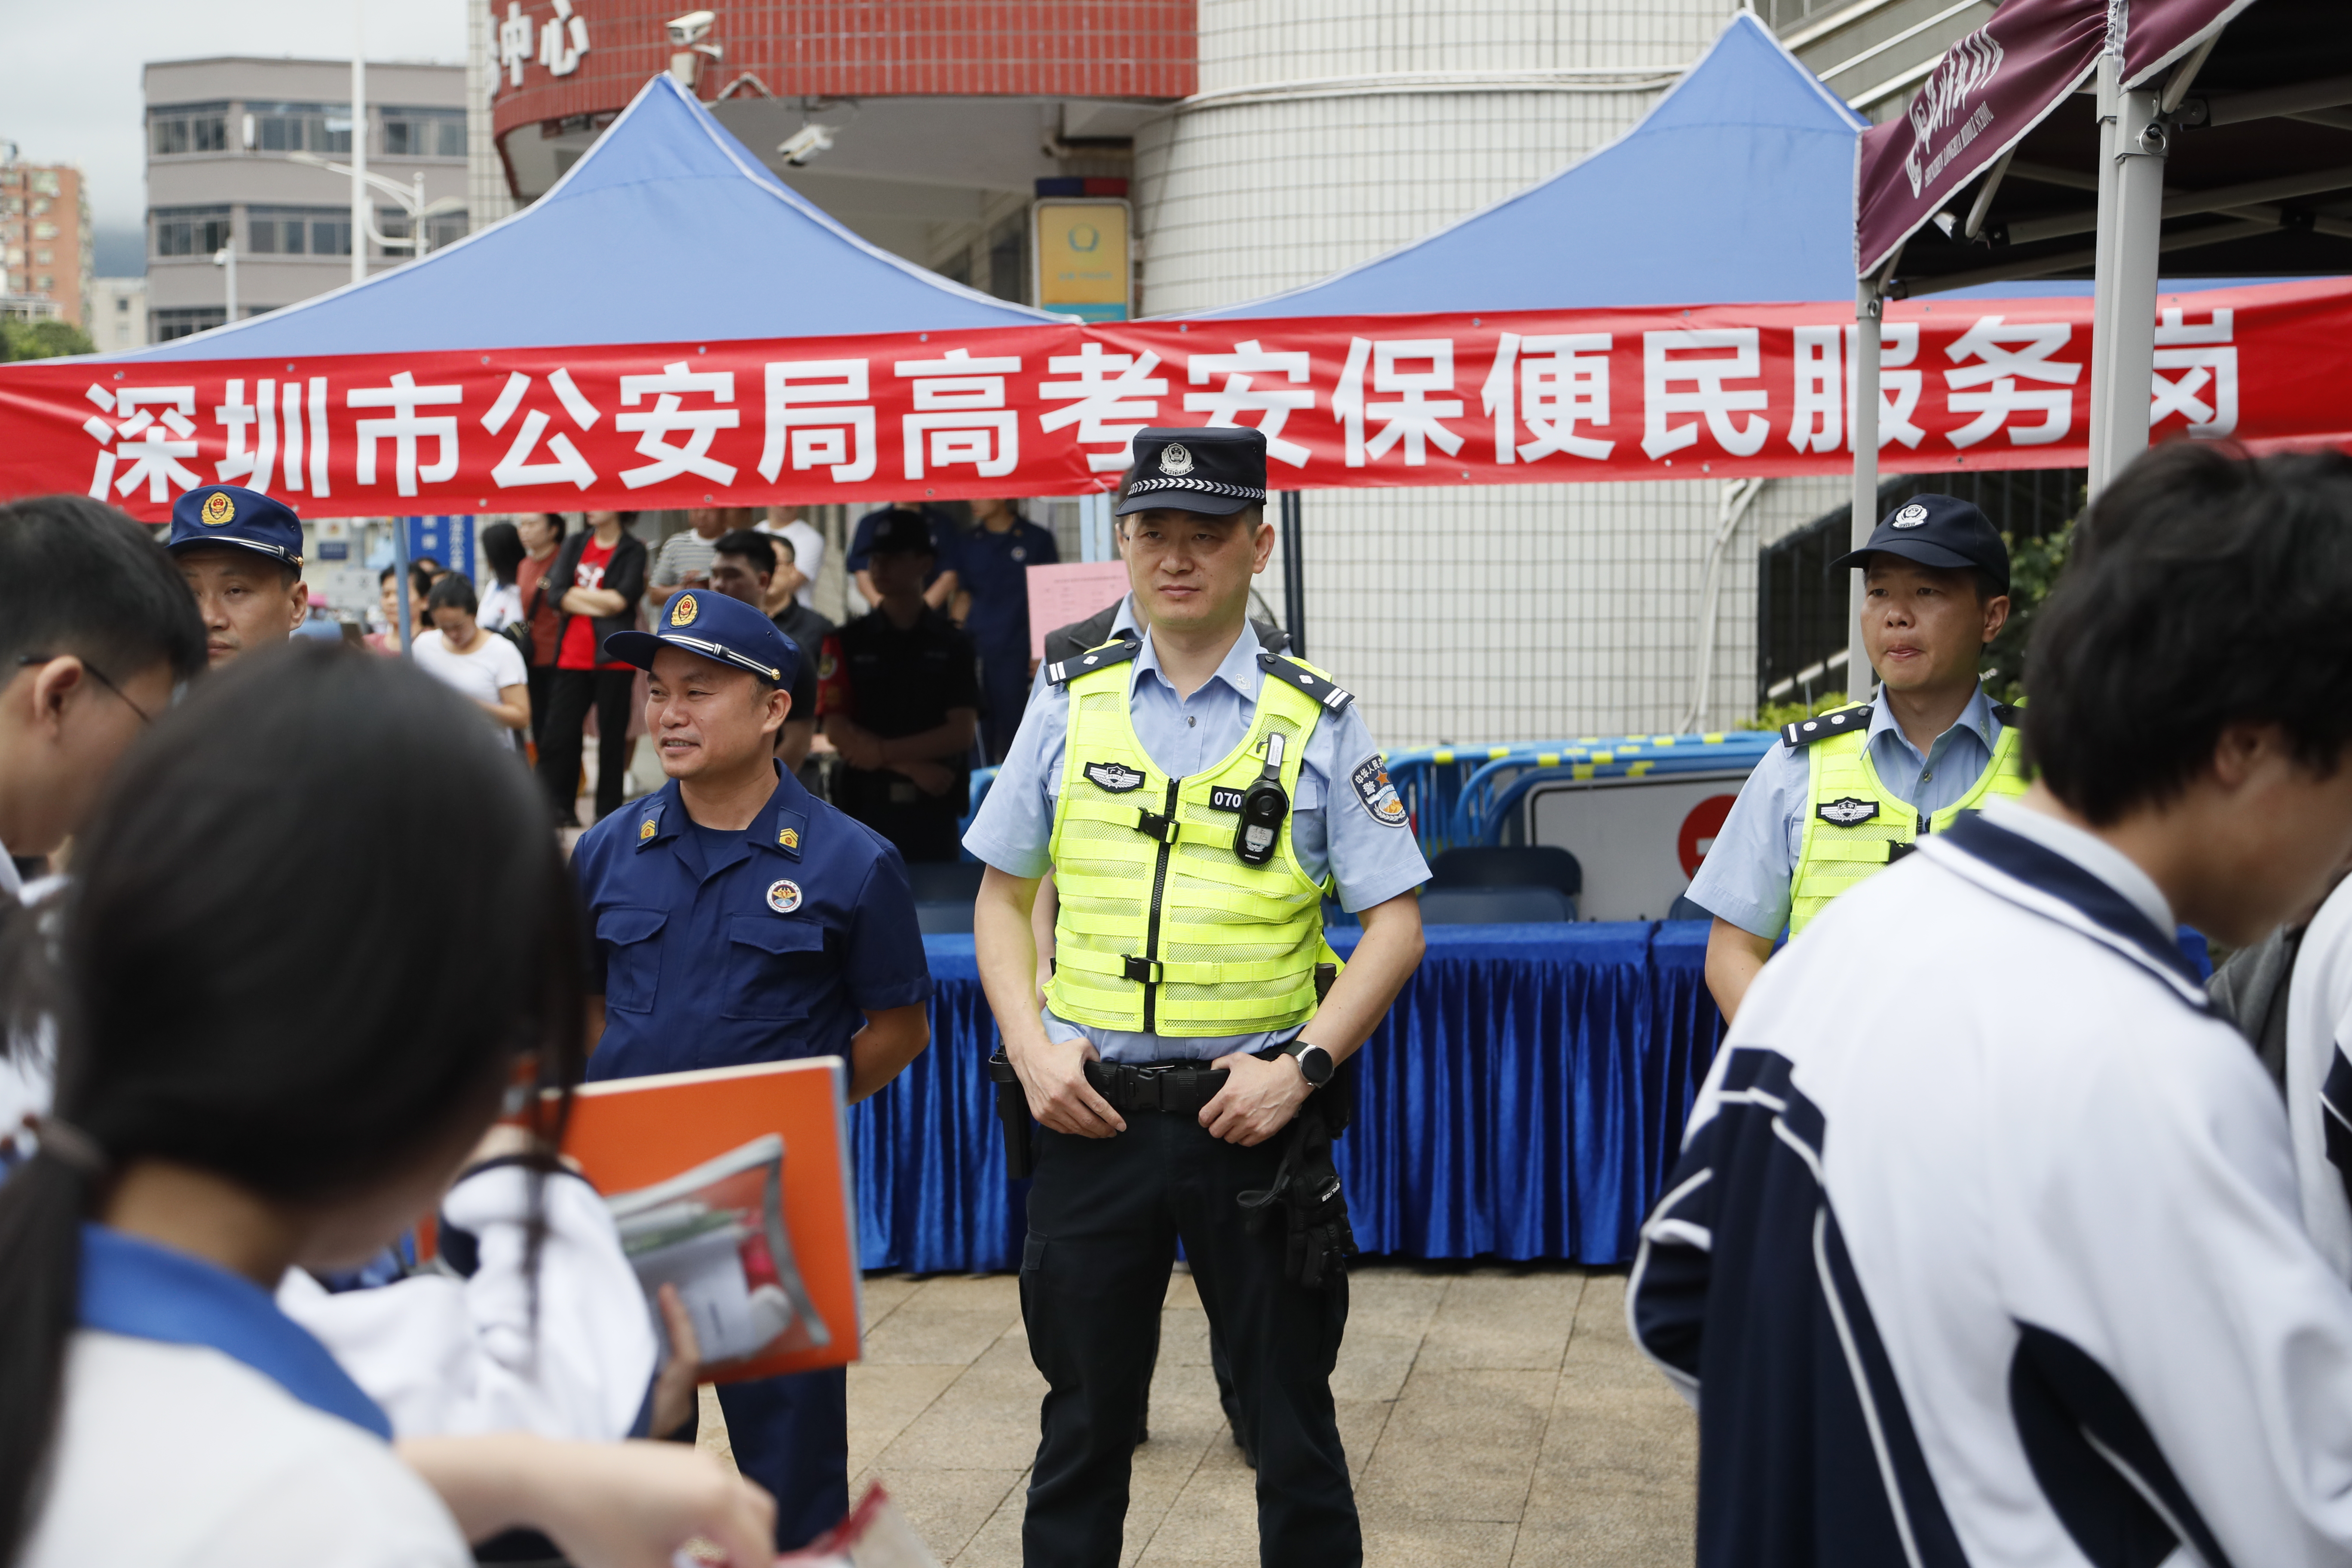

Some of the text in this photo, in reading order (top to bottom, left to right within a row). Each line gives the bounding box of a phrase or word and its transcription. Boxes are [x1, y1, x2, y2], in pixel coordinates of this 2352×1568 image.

[485, 0, 590, 87] 中心
[1974, 101, 1994, 132] SCHOOL
[83, 307, 2239, 503] 深圳市公安局高考安保便民服务岗
[1214, 791, 1245, 808] 070
